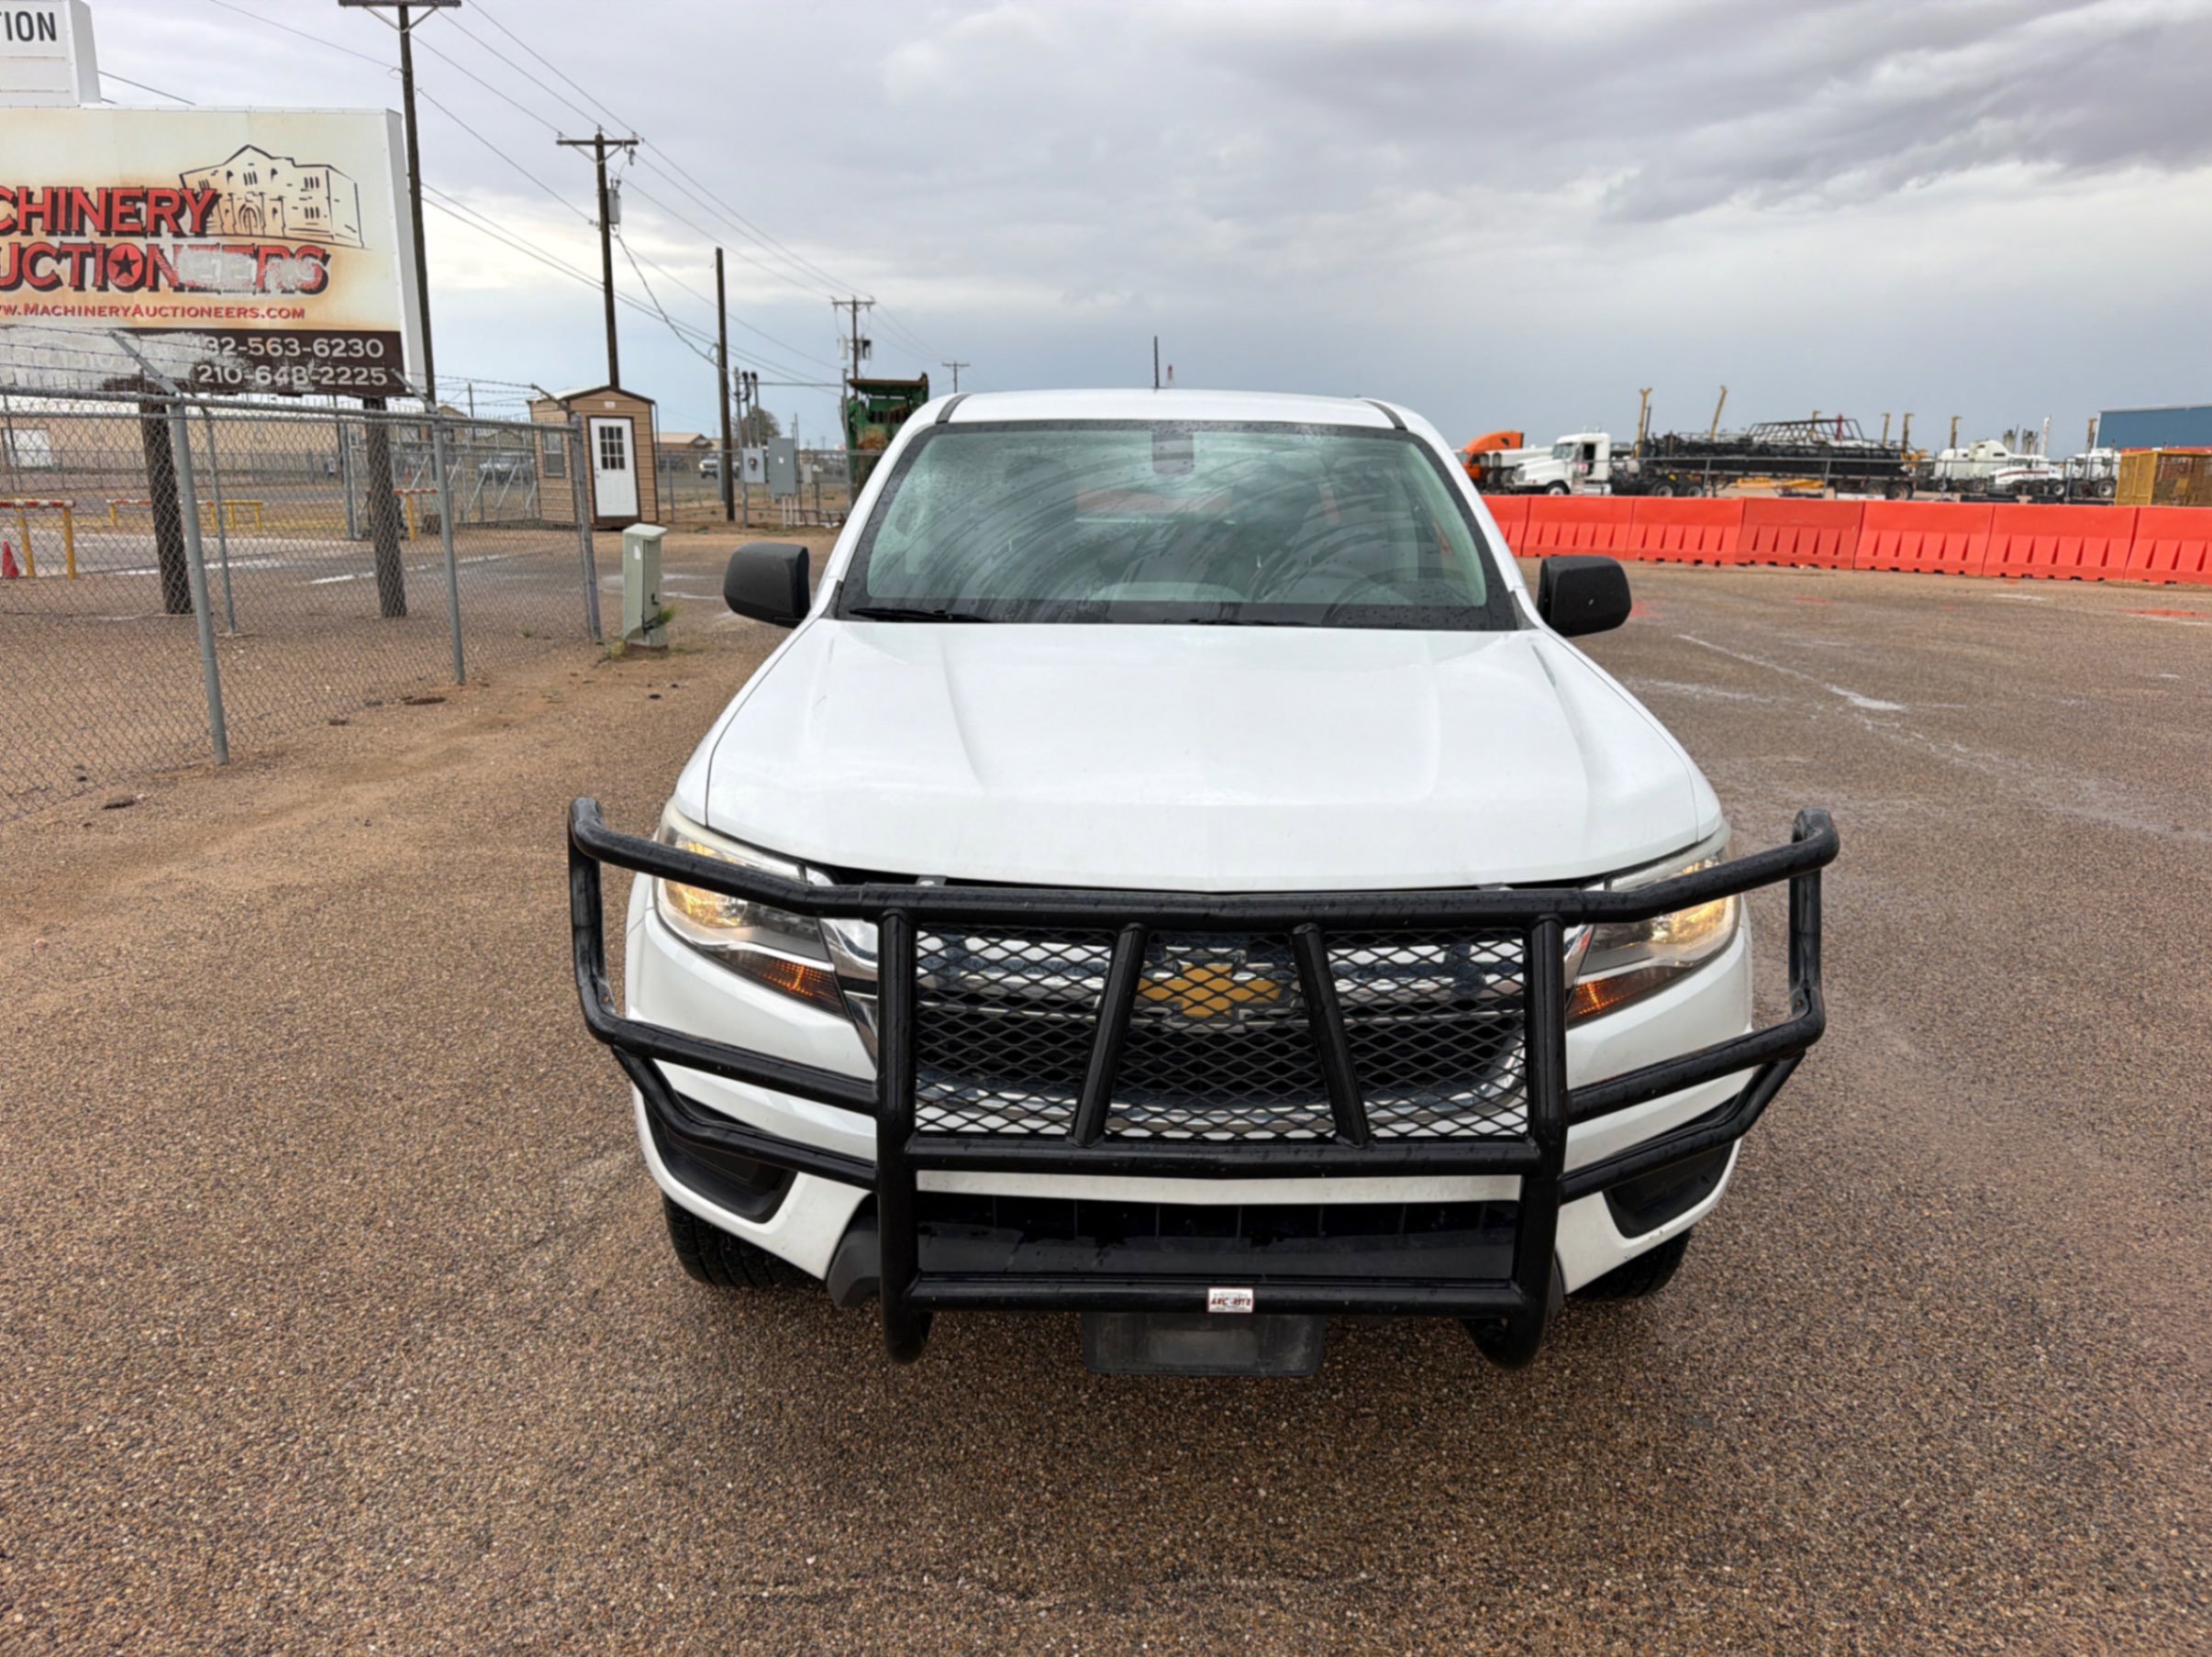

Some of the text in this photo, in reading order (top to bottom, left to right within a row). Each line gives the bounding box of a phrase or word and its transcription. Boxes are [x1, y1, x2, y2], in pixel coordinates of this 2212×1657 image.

[0, 11, 57, 42] ION
[0, 241, 330, 295] UCTIONRS
[0, 303, 306, 320] W.MACHINERYAUCTIONEERS.COM
[191, 336, 384, 359] 32-563-6230
[196, 364, 388, 386] 210-648-2225
